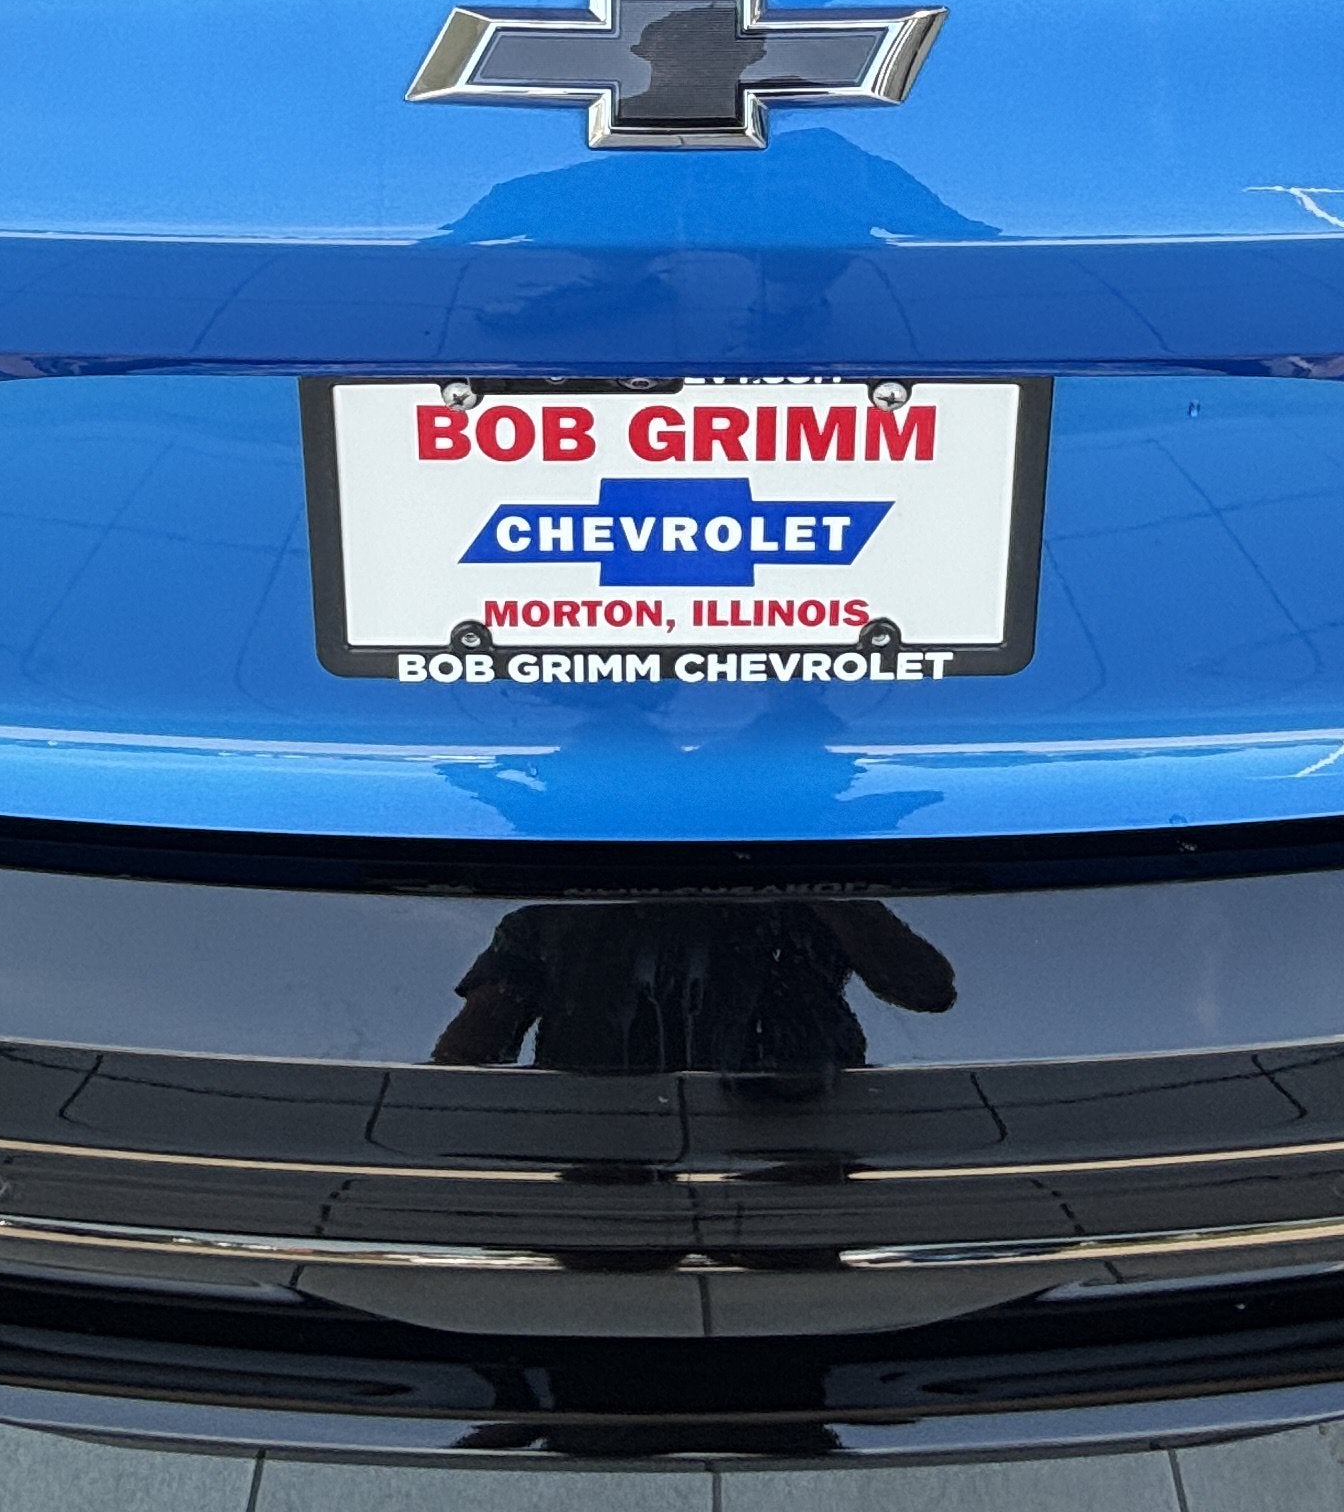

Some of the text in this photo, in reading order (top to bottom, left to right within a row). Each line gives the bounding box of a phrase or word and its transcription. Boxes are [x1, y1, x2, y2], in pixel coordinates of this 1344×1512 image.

[416, 405, 935, 462] BOB GRIMM
[496, 515, 852, 552] CHEVROLET
[484, 599, 870, 633] MORTON, ILLINOIS
[397, 651, 954, 684] BOB GRIMM CHEVROLET
